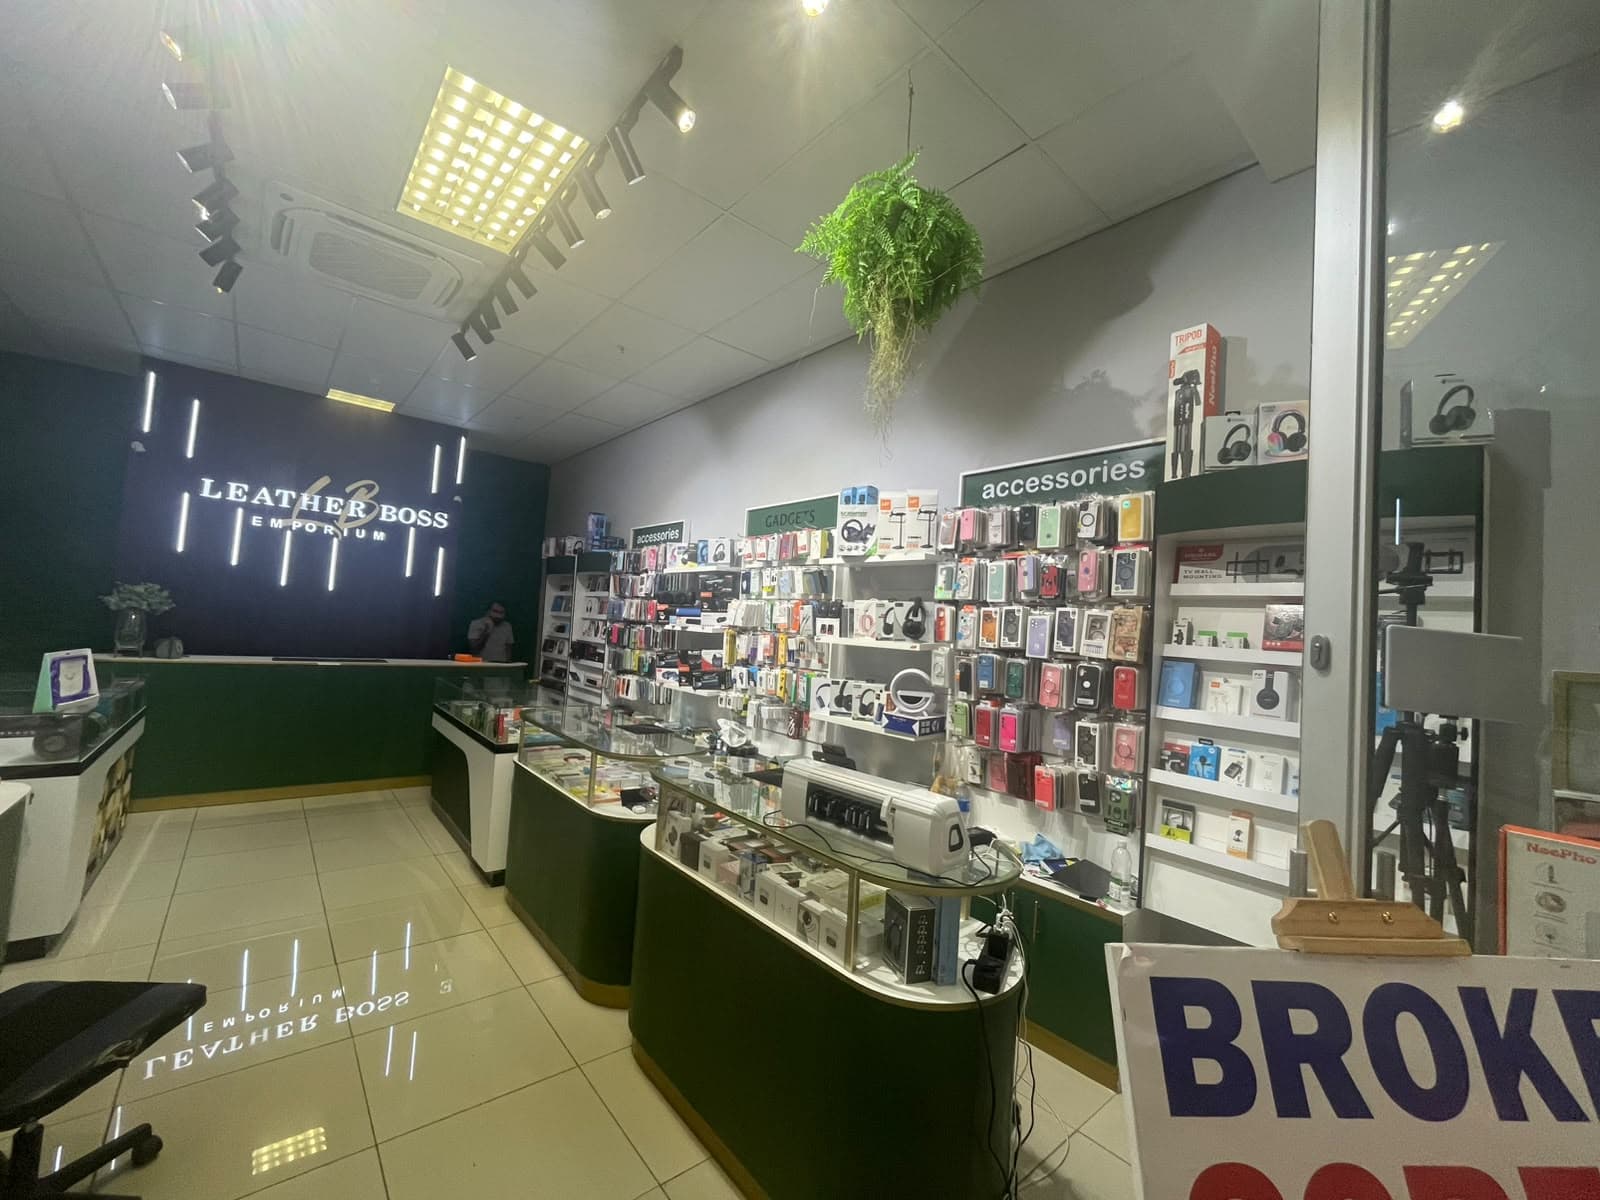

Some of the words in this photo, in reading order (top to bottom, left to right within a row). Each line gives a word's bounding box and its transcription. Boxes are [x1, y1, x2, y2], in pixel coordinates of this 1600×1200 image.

[1175, 329, 1203, 346] TRIPOD
[981, 459, 1146, 500] accessories
[200, 477, 367, 518] LEATHER
[378, 503, 449, 529] BOSS
[251, 515, 386, 541] EMPORIUM
[765, 510, 816, 529] GADGETS
[636, 527, 680, 545] accessories
